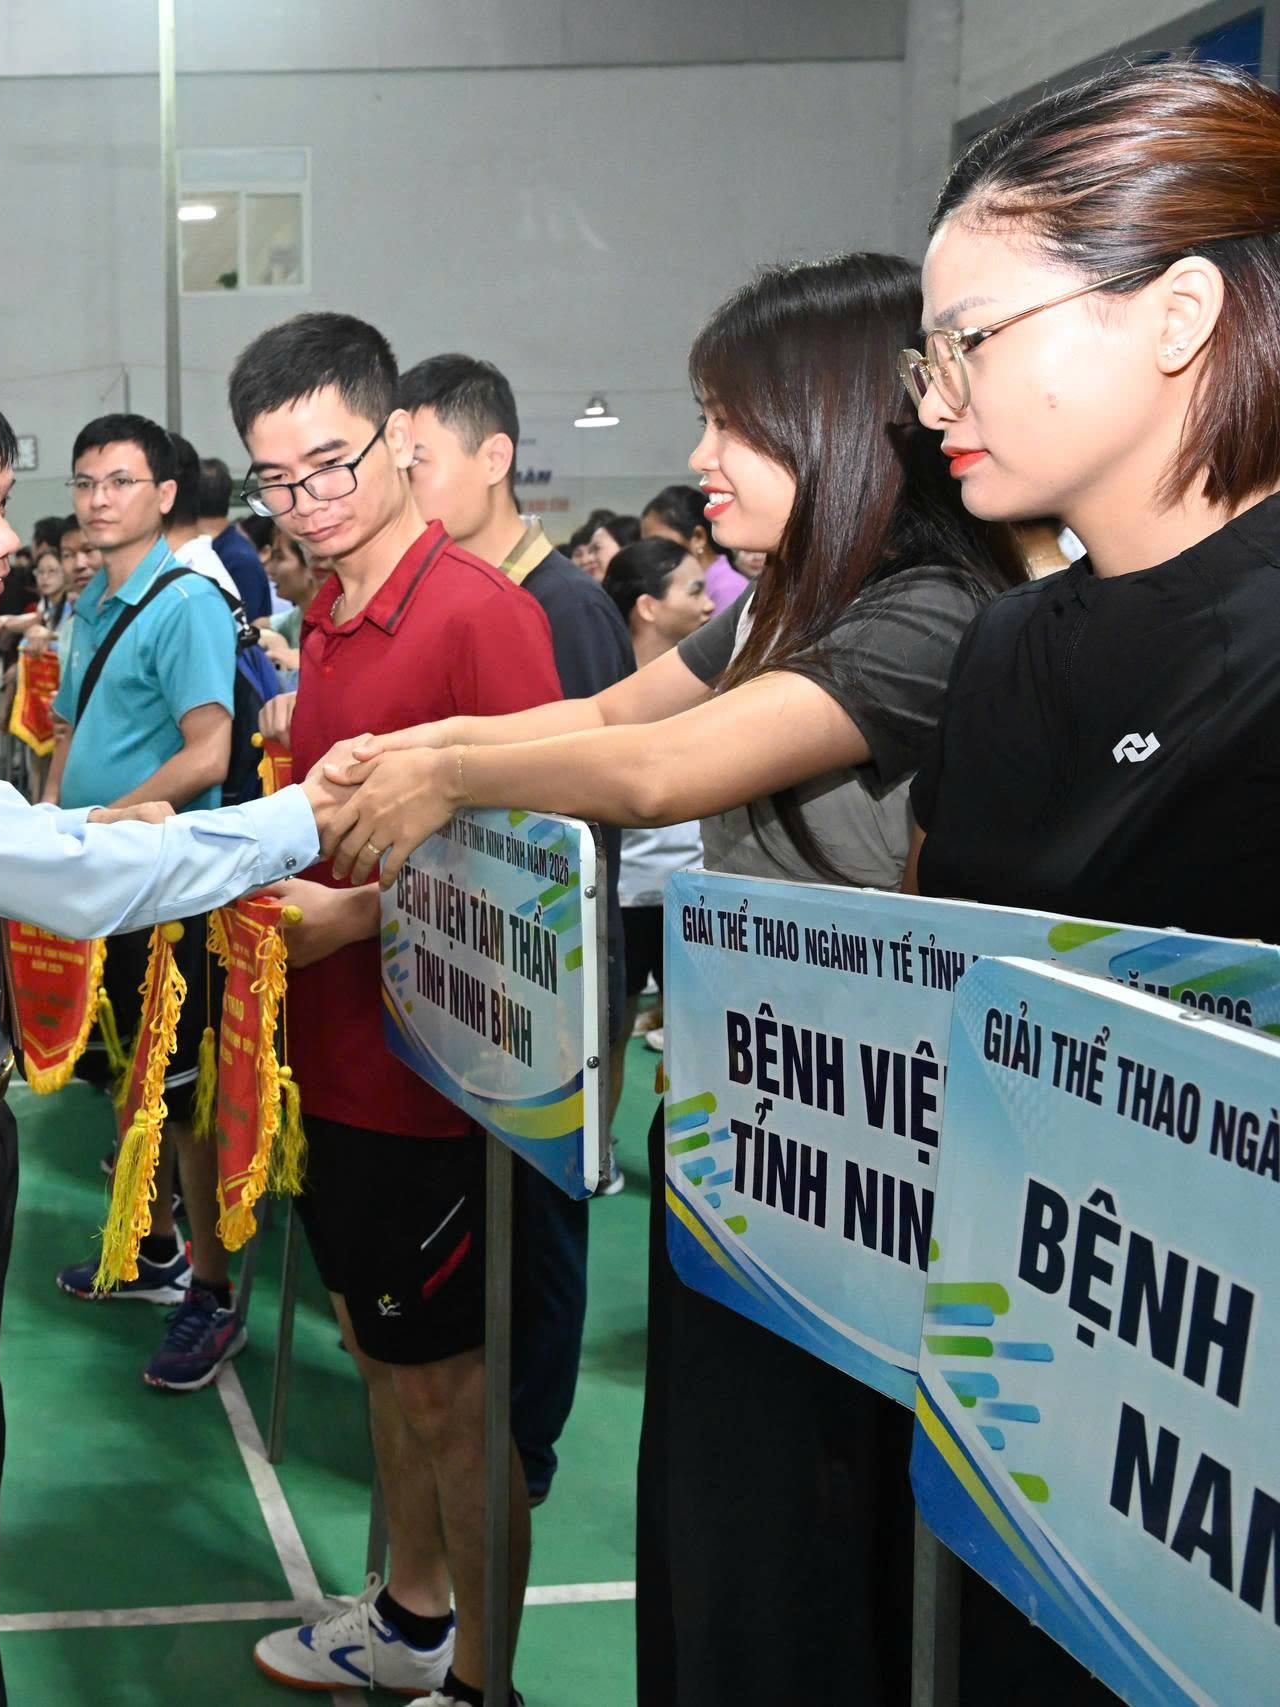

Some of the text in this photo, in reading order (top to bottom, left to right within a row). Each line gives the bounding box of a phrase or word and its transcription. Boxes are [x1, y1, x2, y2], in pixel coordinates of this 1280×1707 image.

[397, 857, 558, 995] BỆNH VIỆN TÂM THẦN
[486, 828, 505, 861] NINH
[506, 831, 526, 870] BÌNH
[527, 839, 548, 878] NĂM
[549, 851, 569, 887] 2026
[414, 931, 533, 1068] TỈNH NINH BÌNH
[681, 895, 714, 946] GIẢI
[717, 899, 750, 954] THỂ
[752, 918, 800, 963] THAO
[804, 925, 868, 976] NGÀNH
[873, 939, 885, 978] Y
[889, 930, 914, 984] TẾ
[918, 933, 966, 992] TỈNH
[725, 1002, 948, 1166] BỆNH VIỆ
[983, 1001, 1042, 1079] GIẢI
[1051, 1025, 1111, 1107] THỂ
[1116, 1055, 1202, 1145] THAO
[729, 1103, 829, 1229] TỈNH
[1017, 1176, 1256, 1409] BỆNH
